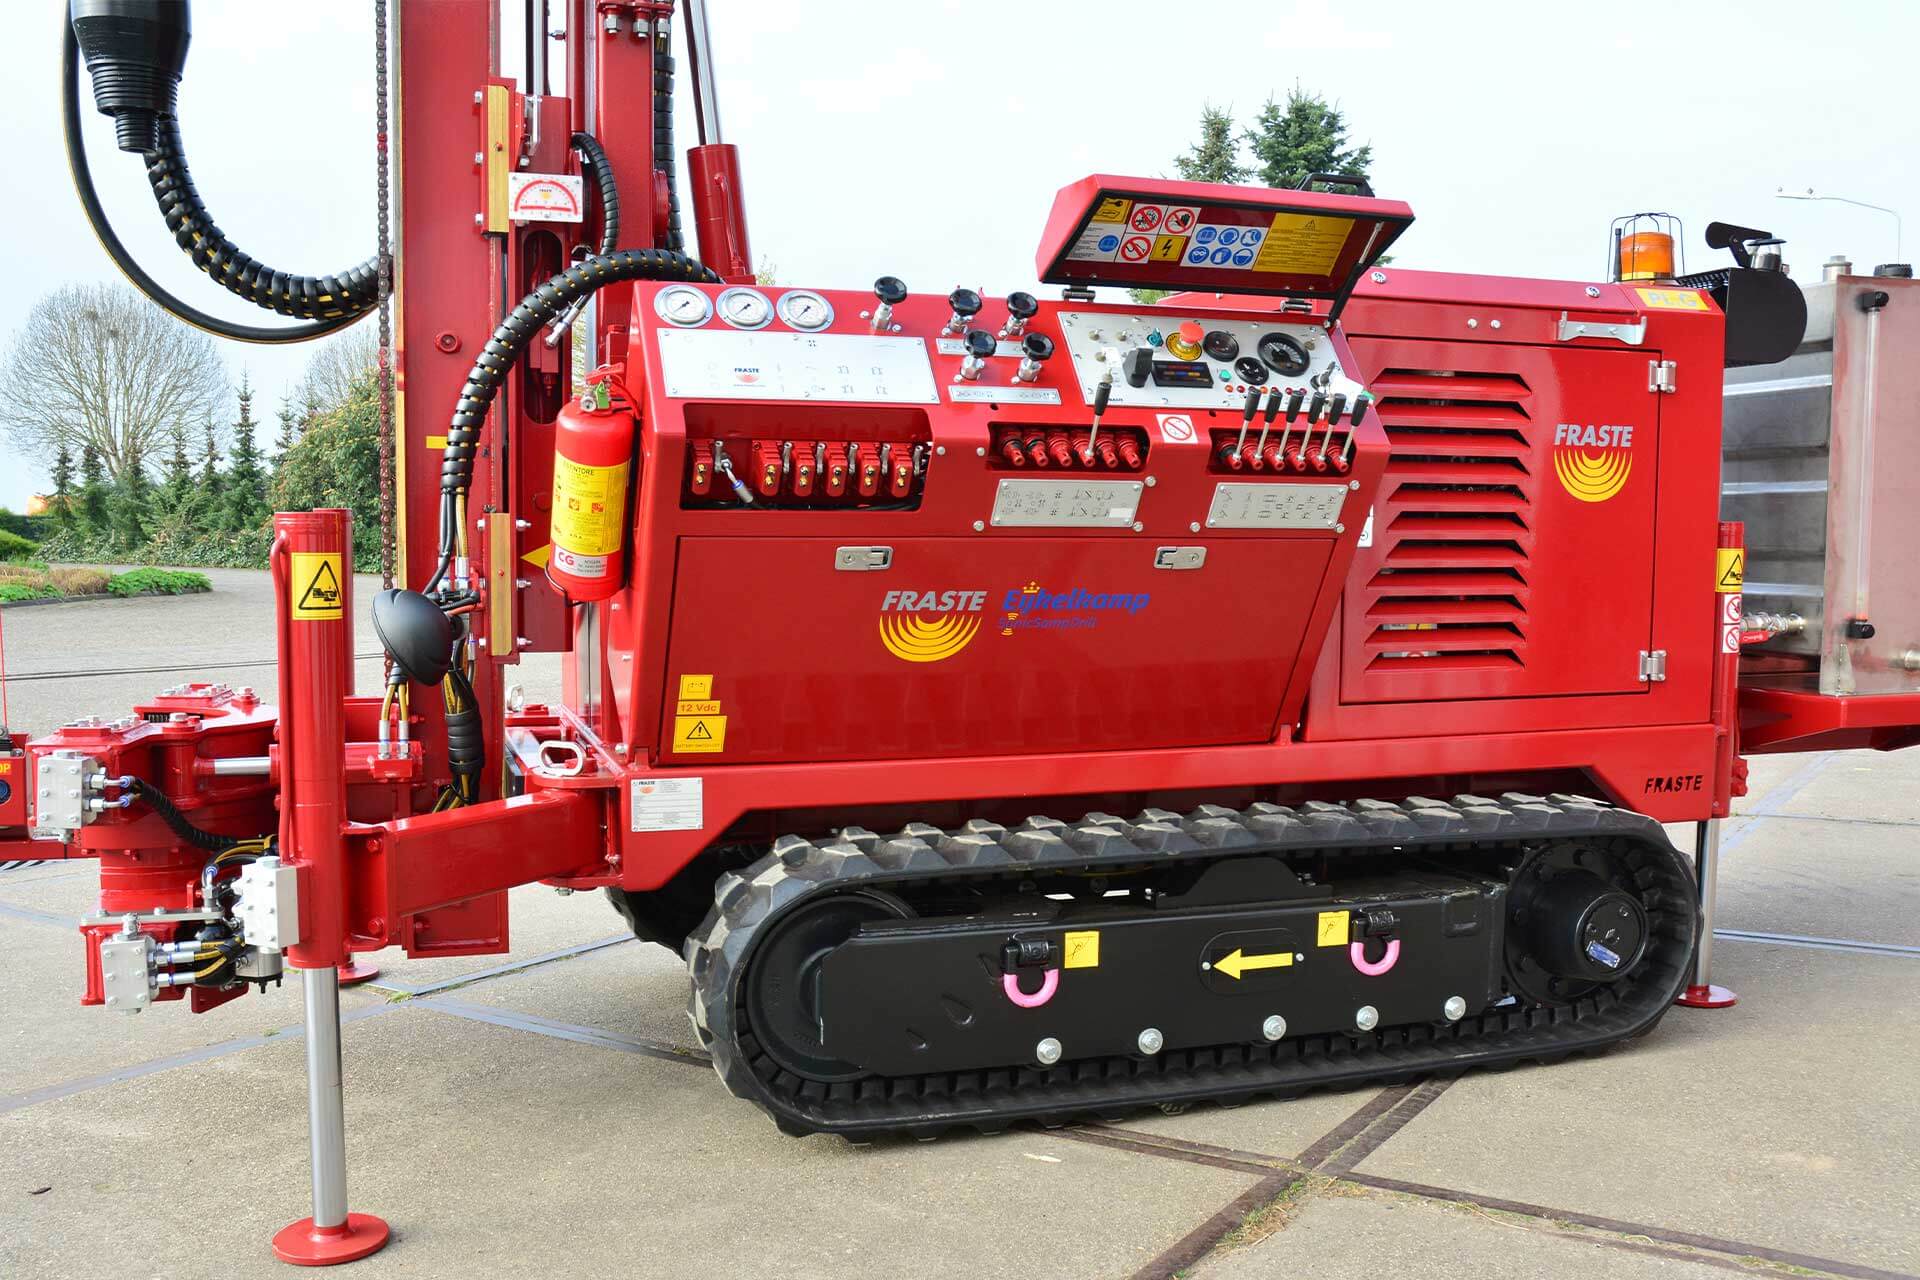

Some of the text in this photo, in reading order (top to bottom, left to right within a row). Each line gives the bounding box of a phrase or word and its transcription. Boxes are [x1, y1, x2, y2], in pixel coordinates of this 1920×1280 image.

[1554, 423, 1634, 448] FRASTE
[558, 551, 575, 566] CG
[880, 590, 989, 611] FRASTE
[681, 703, 717, 712] 12 Vdc
[1644, 774, 1704, 794] FRASTE
